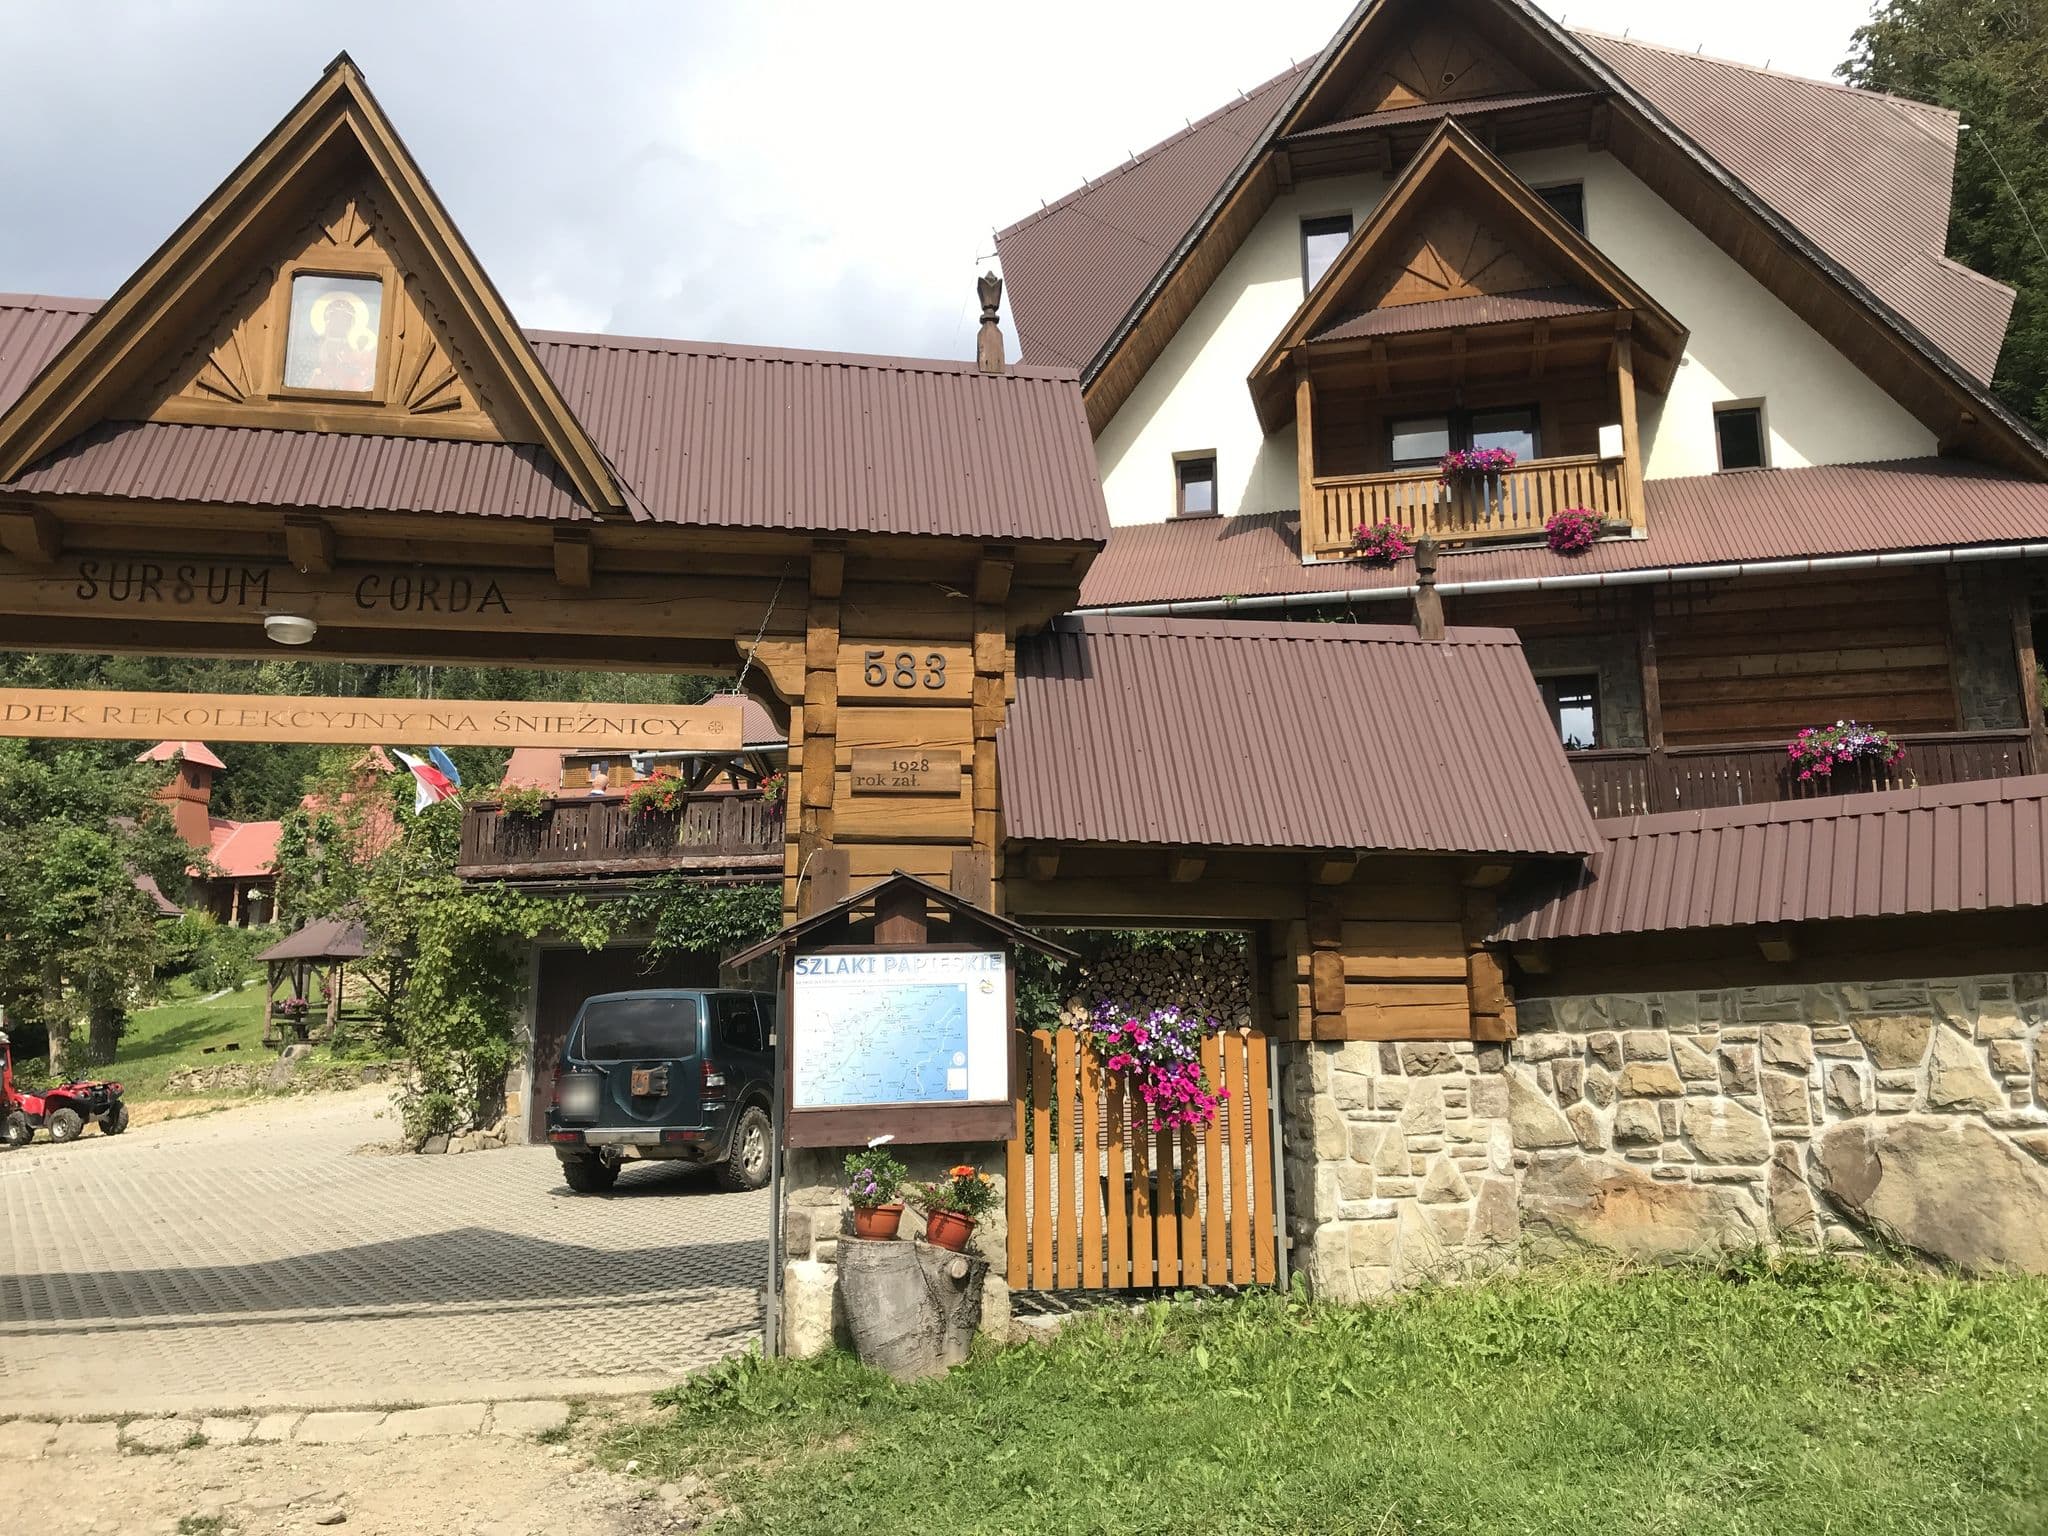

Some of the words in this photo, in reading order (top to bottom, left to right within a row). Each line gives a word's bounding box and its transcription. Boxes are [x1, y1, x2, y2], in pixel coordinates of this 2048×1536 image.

[76, 560, 270, 606] SURSUM
[355, 574, 513, 614] CORDA
[864, 650, 946, 689] 583
[3, 704, 85, 723] DEK
[102, 706, 415, 730] REKOLEKCYJNY
[428, 714, 479, 731] NA
[493, 710, 691, 736] ŚNIEŻNICY
[891, 758, 929, 774] 1928
[856, 774, 886, 787] rok
[891, 774, 921, 787] zał.
[796, 957, 876, 976] SZLAKI
